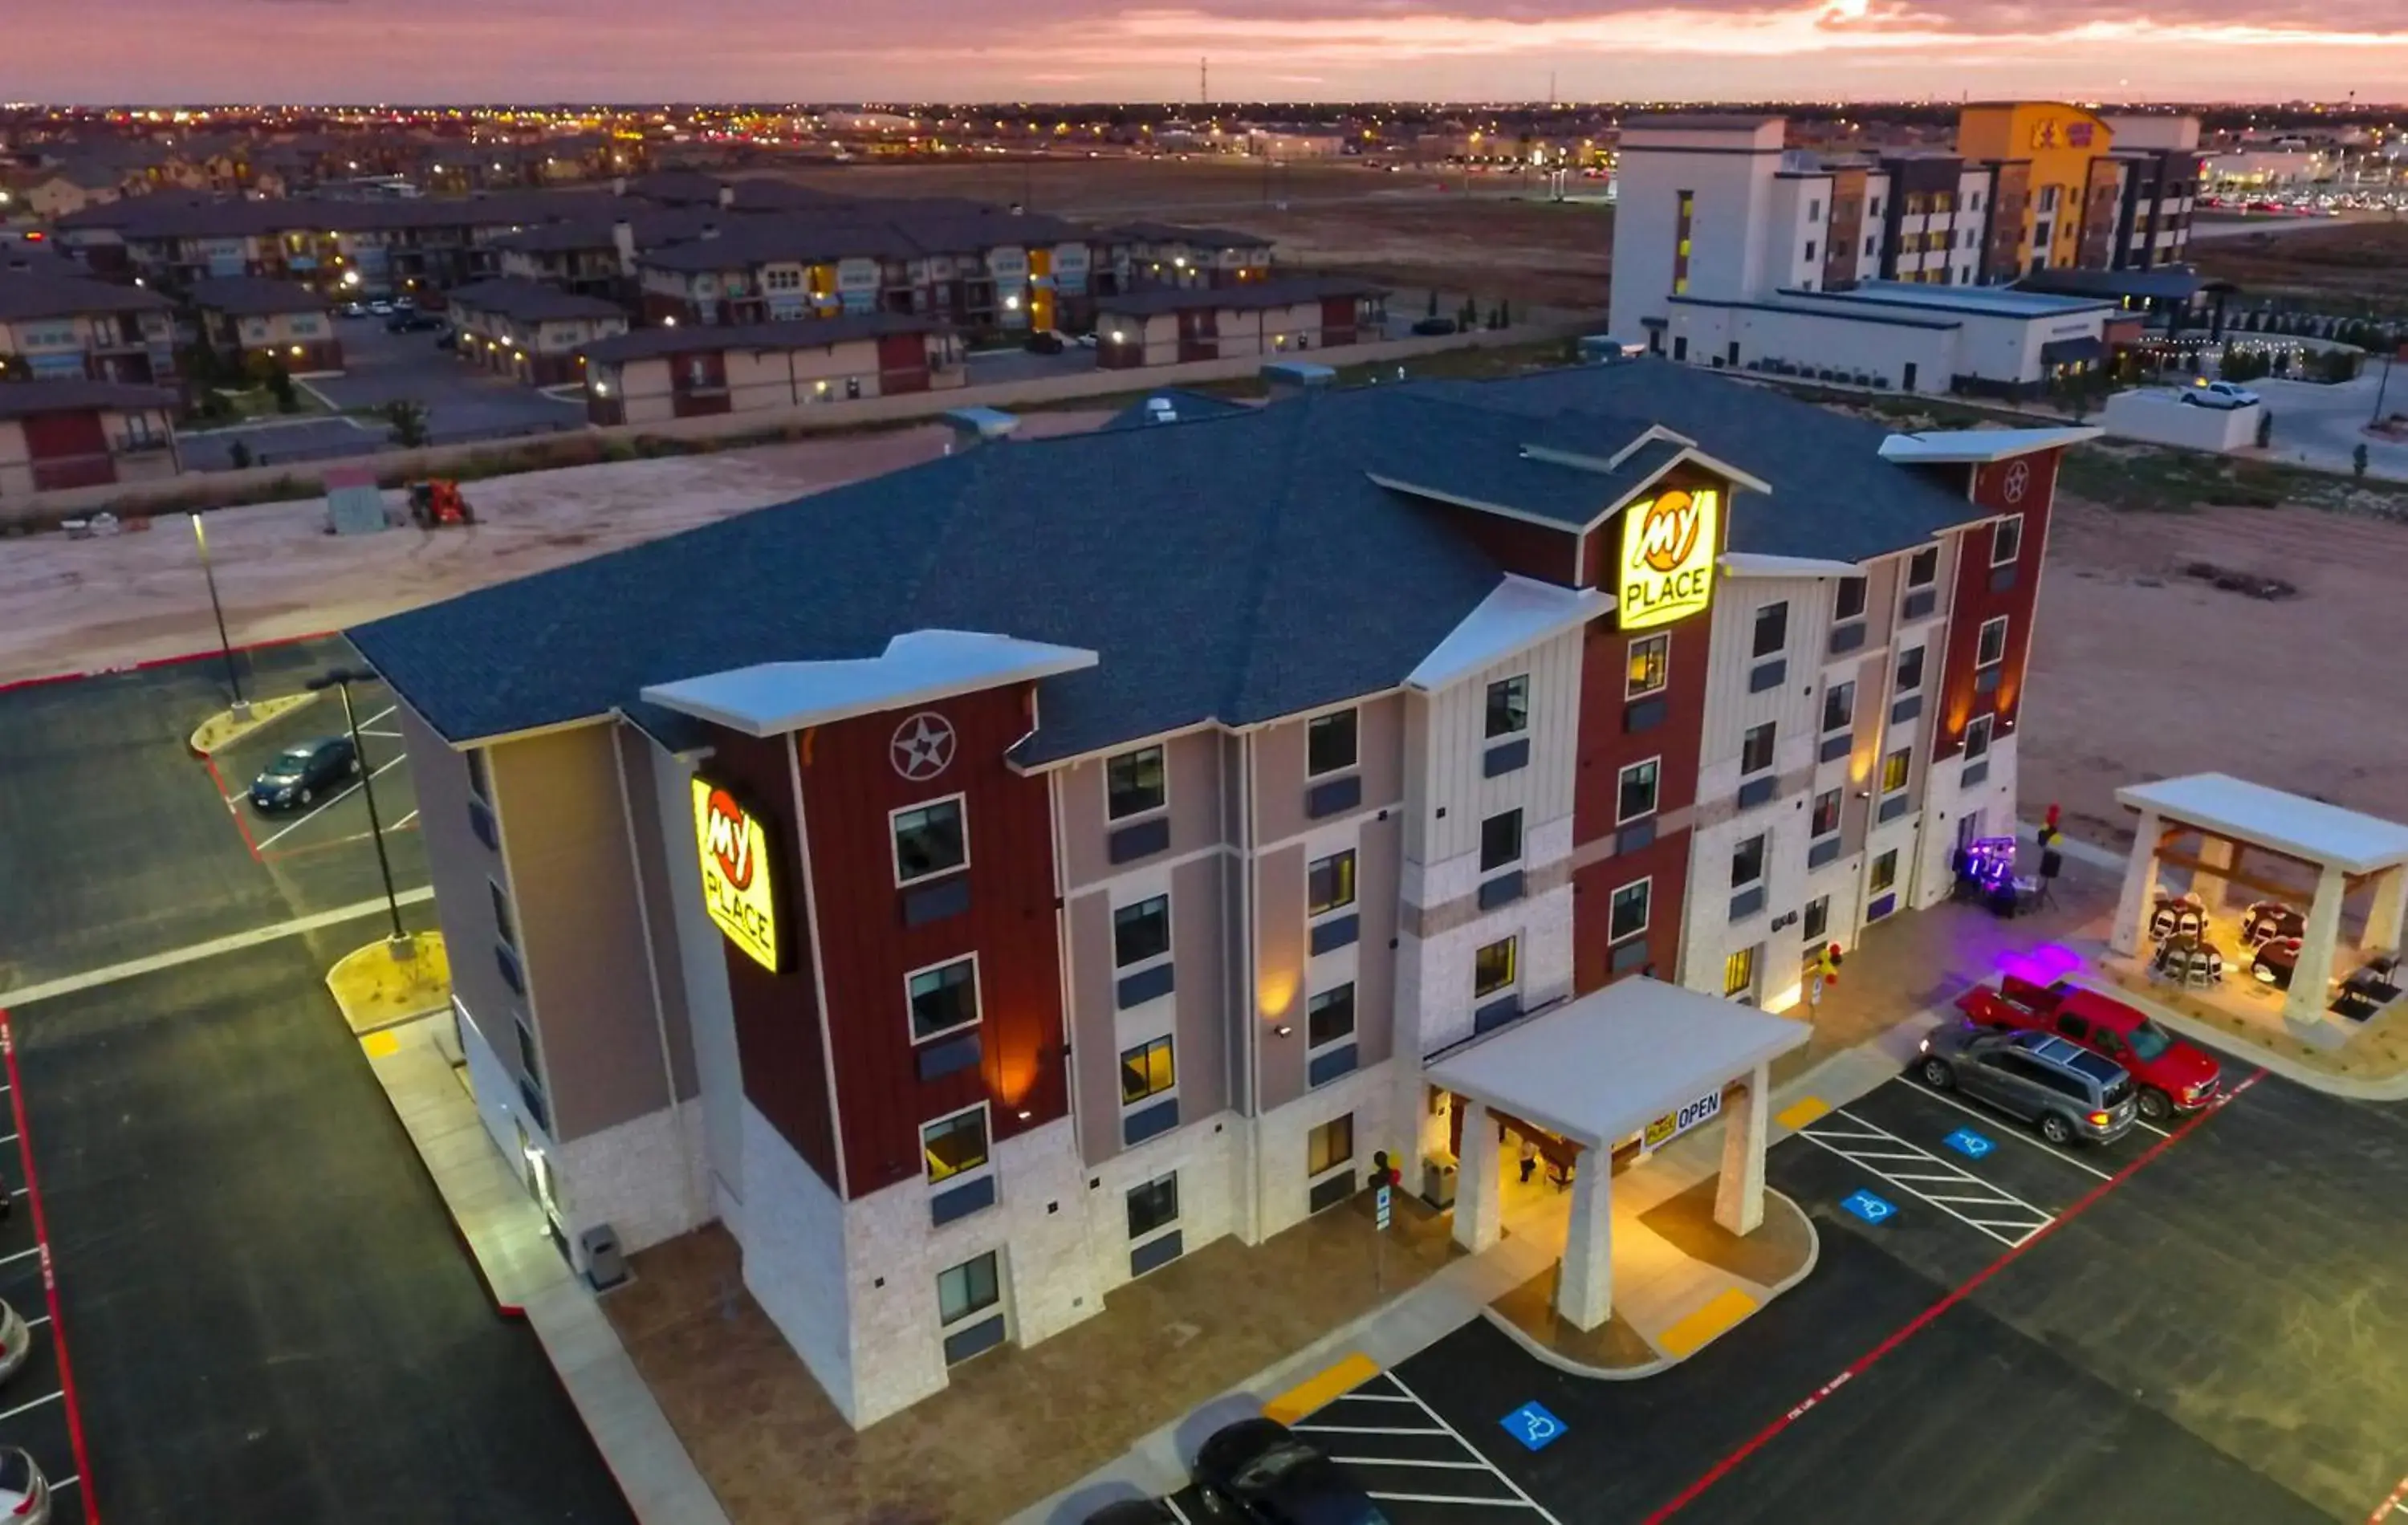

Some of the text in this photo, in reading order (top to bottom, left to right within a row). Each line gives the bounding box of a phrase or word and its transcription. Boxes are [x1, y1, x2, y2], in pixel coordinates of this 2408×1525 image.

[1626, 567, 1706, 612] PLACE
[706, 870, 771, 949] PLACE
[1678, 1092, 1719, 1128] OPEN
